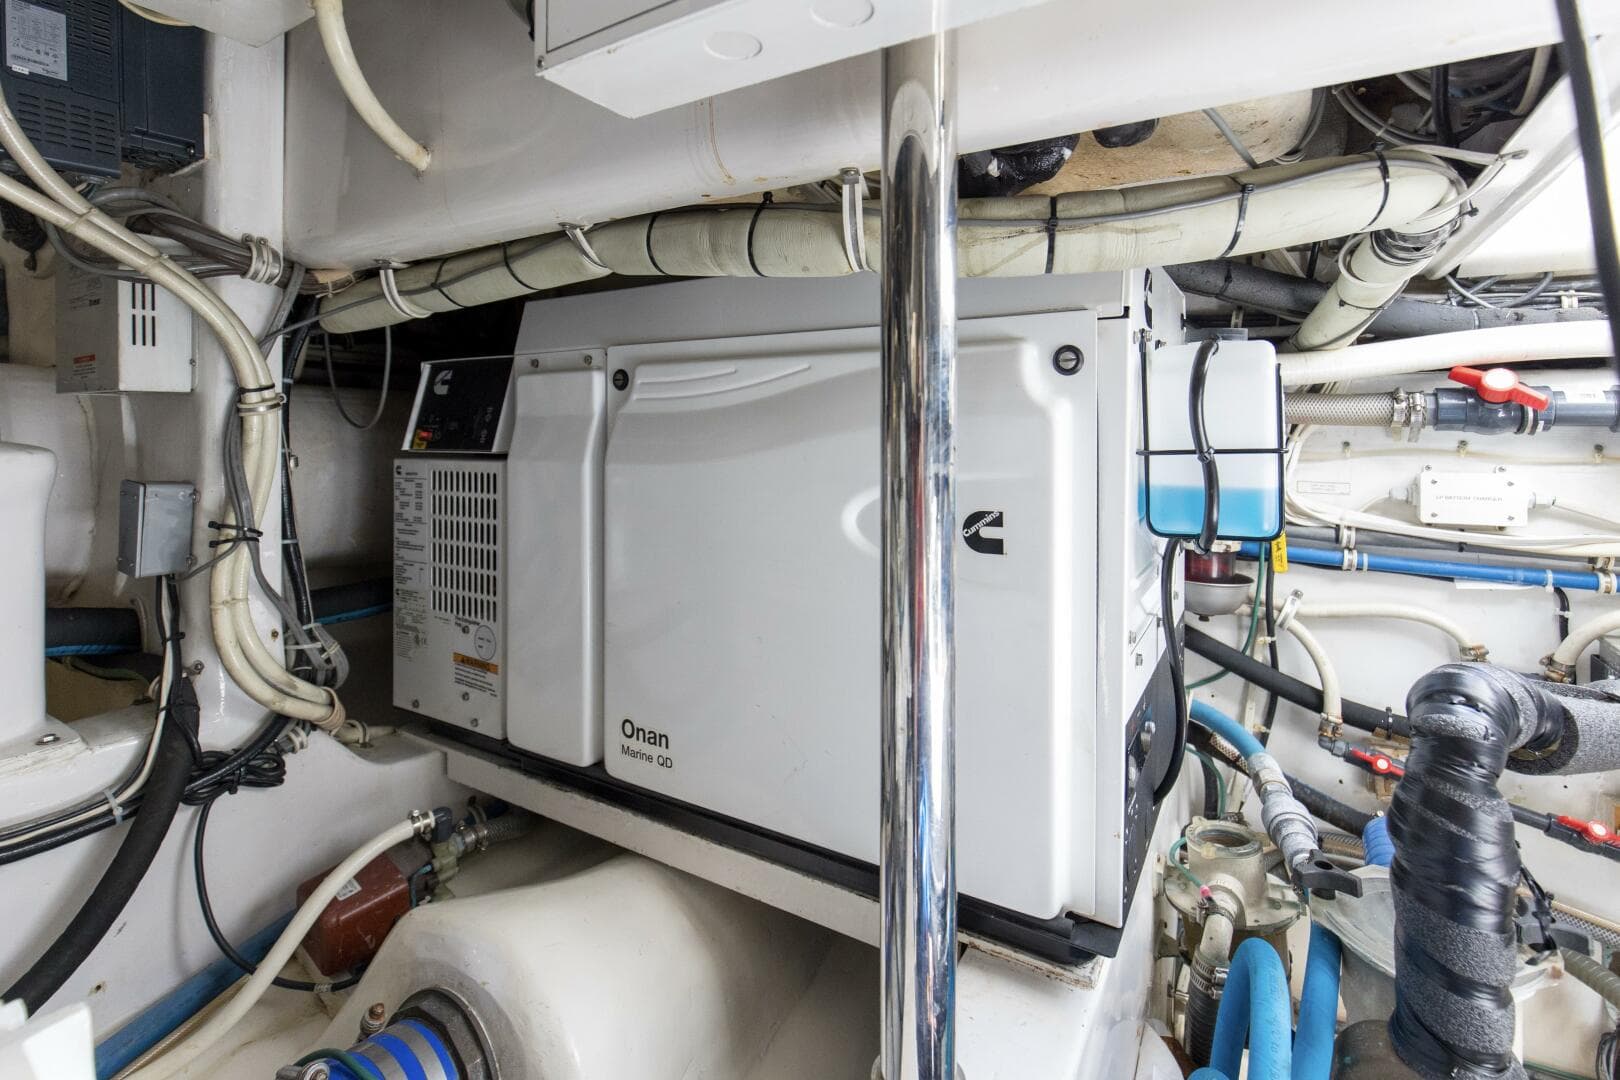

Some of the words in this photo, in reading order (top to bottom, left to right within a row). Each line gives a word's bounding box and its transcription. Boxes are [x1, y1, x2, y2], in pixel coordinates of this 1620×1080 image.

[963, 510, 1000, 538] Cummins
[621, 718, 669, 750] Onan
[621, 743, 654, 764] Marine
[657, 754, 673, 769] QD
